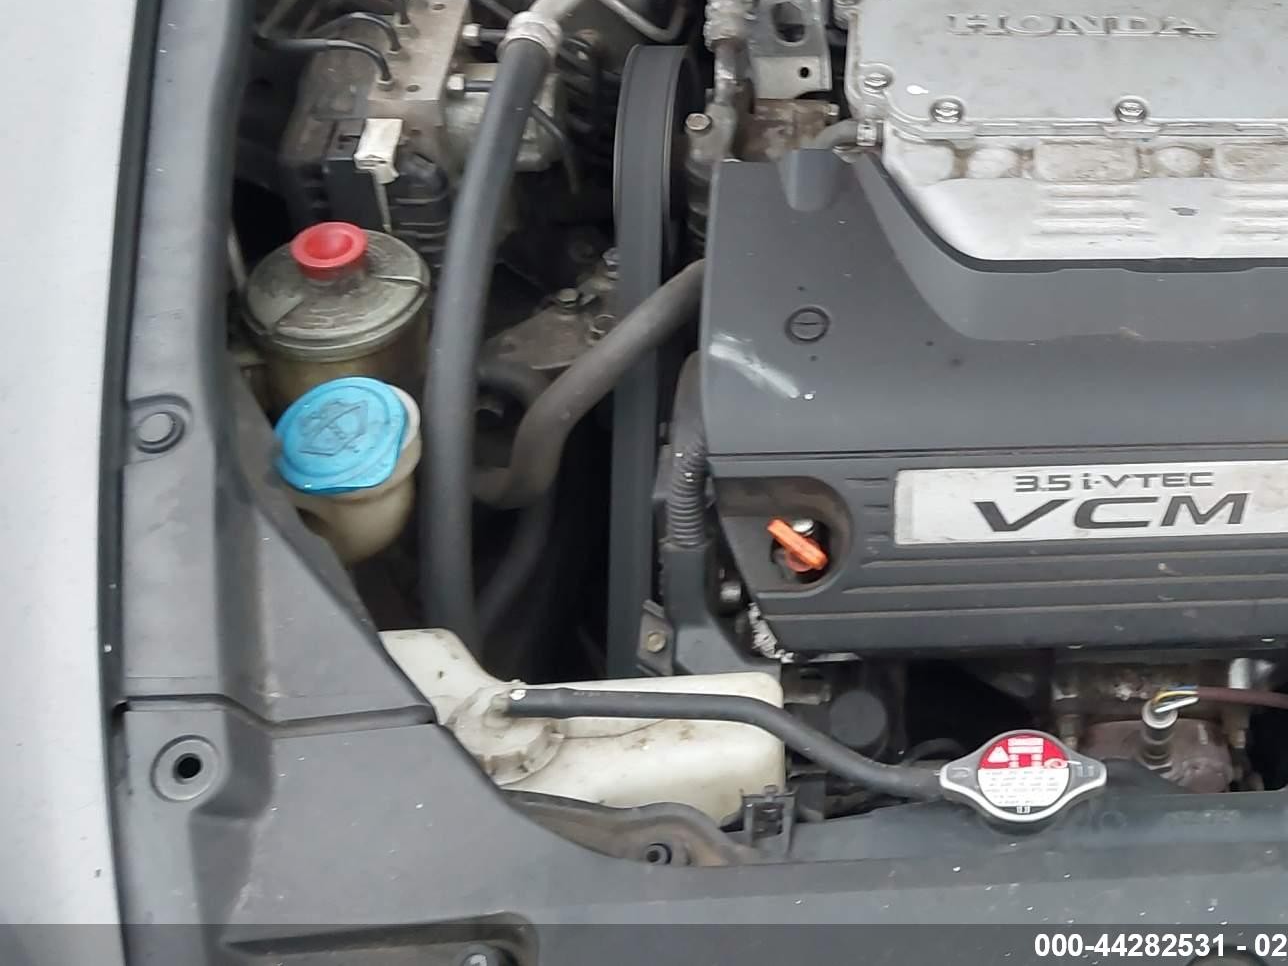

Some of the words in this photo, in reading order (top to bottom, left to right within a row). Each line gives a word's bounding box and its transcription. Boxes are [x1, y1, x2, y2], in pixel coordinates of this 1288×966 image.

[946, 14, 1217, 37] HONDA
[1015, 475, 1071, 493] 3.5
[974, 493, 1250, 534] VCM
